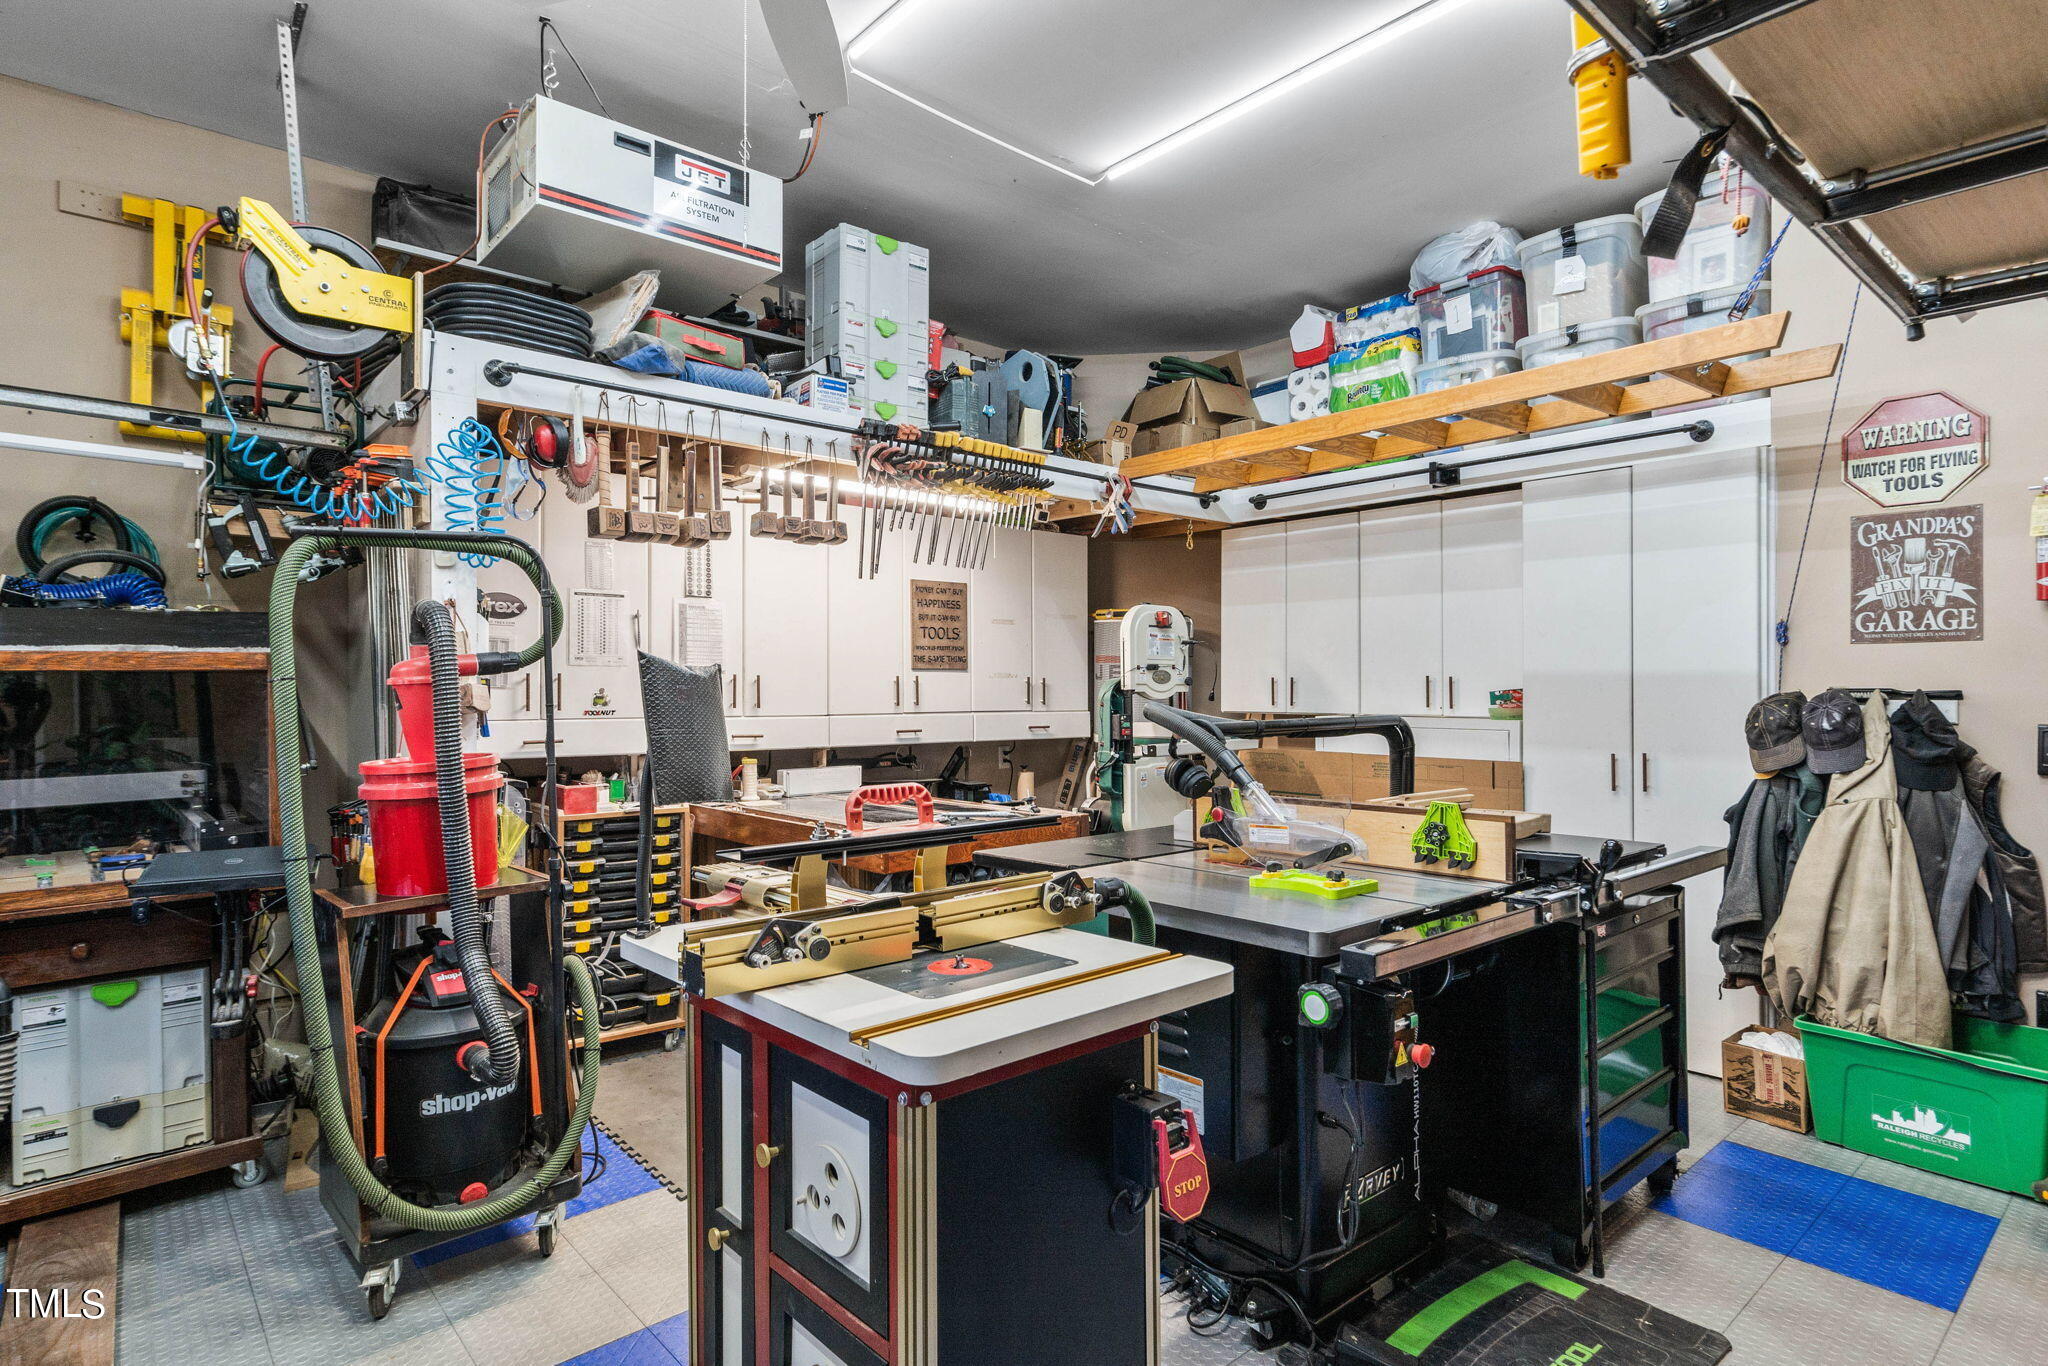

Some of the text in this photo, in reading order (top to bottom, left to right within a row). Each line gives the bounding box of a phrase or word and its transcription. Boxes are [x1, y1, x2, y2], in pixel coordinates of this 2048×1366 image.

[681, 167, 726, 189] JET
[686, 206, 720, 223] SYSTEM
[687, 196, 735, 217] FILTRATION
[368, 295, 408, 308] CENTRAL
[1113, 425, 1128, 439] PD
[1860, 413, 1972, 450] WARNING
[1852, 449, 1978, 479] WATCH FOR FLYING
[1883, 472, 1944, 493] TOOLS
[1857, 515, 1975, 547] GRANDPA'S
[1880, 579, 1909, 592] FIX
[487, 601, 520, 613] rex
[917, 599, 961, 610] HAPPINESS
[1855, 607, 1979, 633] GARAGE
[919, 626, 961, 640] TOOLS
[913, 655, 926, 663] THE
[1877, 1121, 1918, 1138] RALEIGH
[1919, 1133, 1966, 1151] RECYCLES
[1174, 1174, 1202, 1198] STOP
